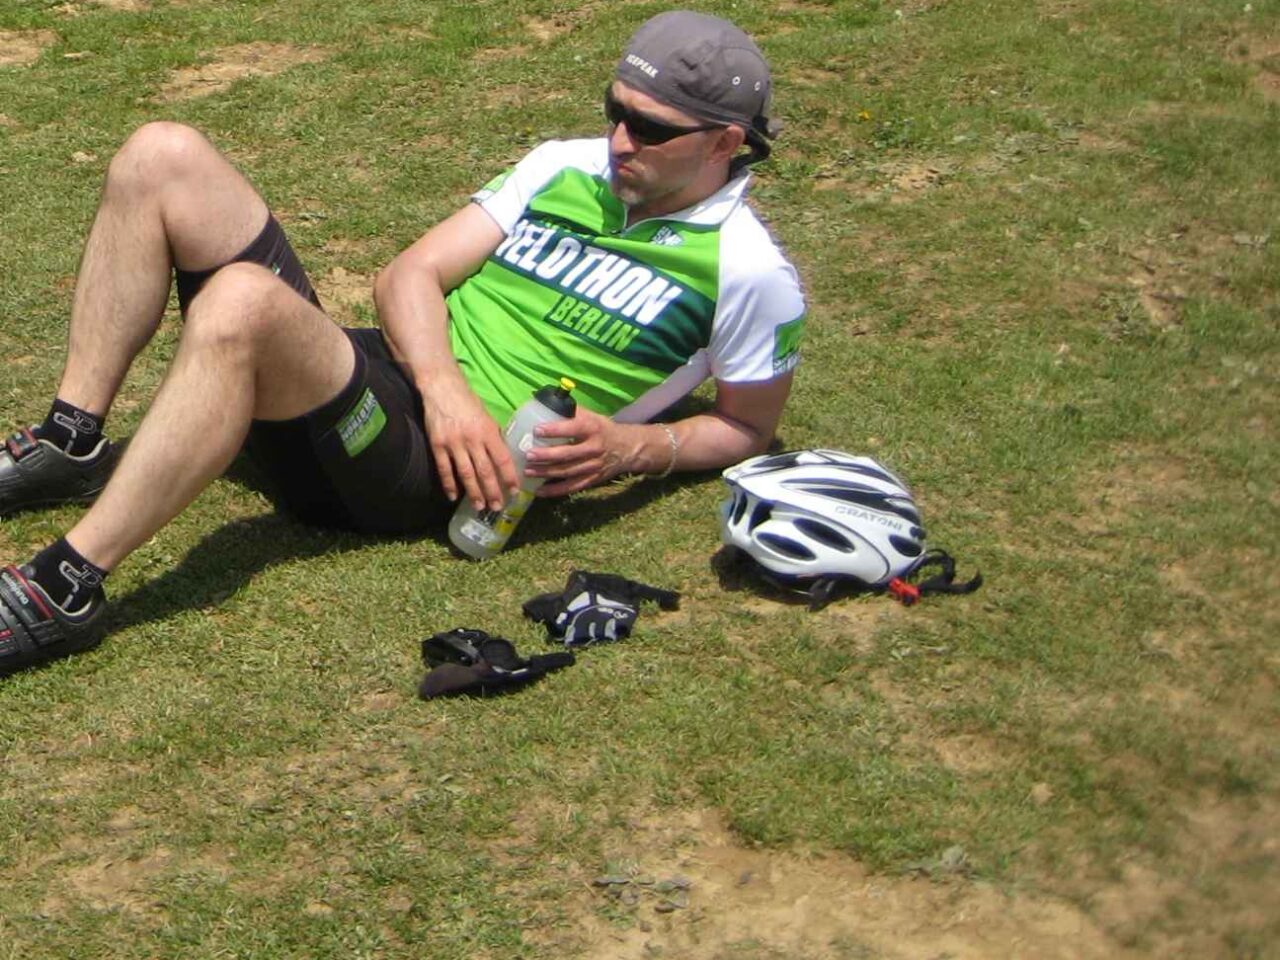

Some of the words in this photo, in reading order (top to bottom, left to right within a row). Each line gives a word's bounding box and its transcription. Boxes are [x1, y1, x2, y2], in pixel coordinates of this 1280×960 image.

[625, 54, 659, 78] ICEPEAK
[550, 295, 640, 352] BERLIN
[835, 505, 903, 531] CRATONI
